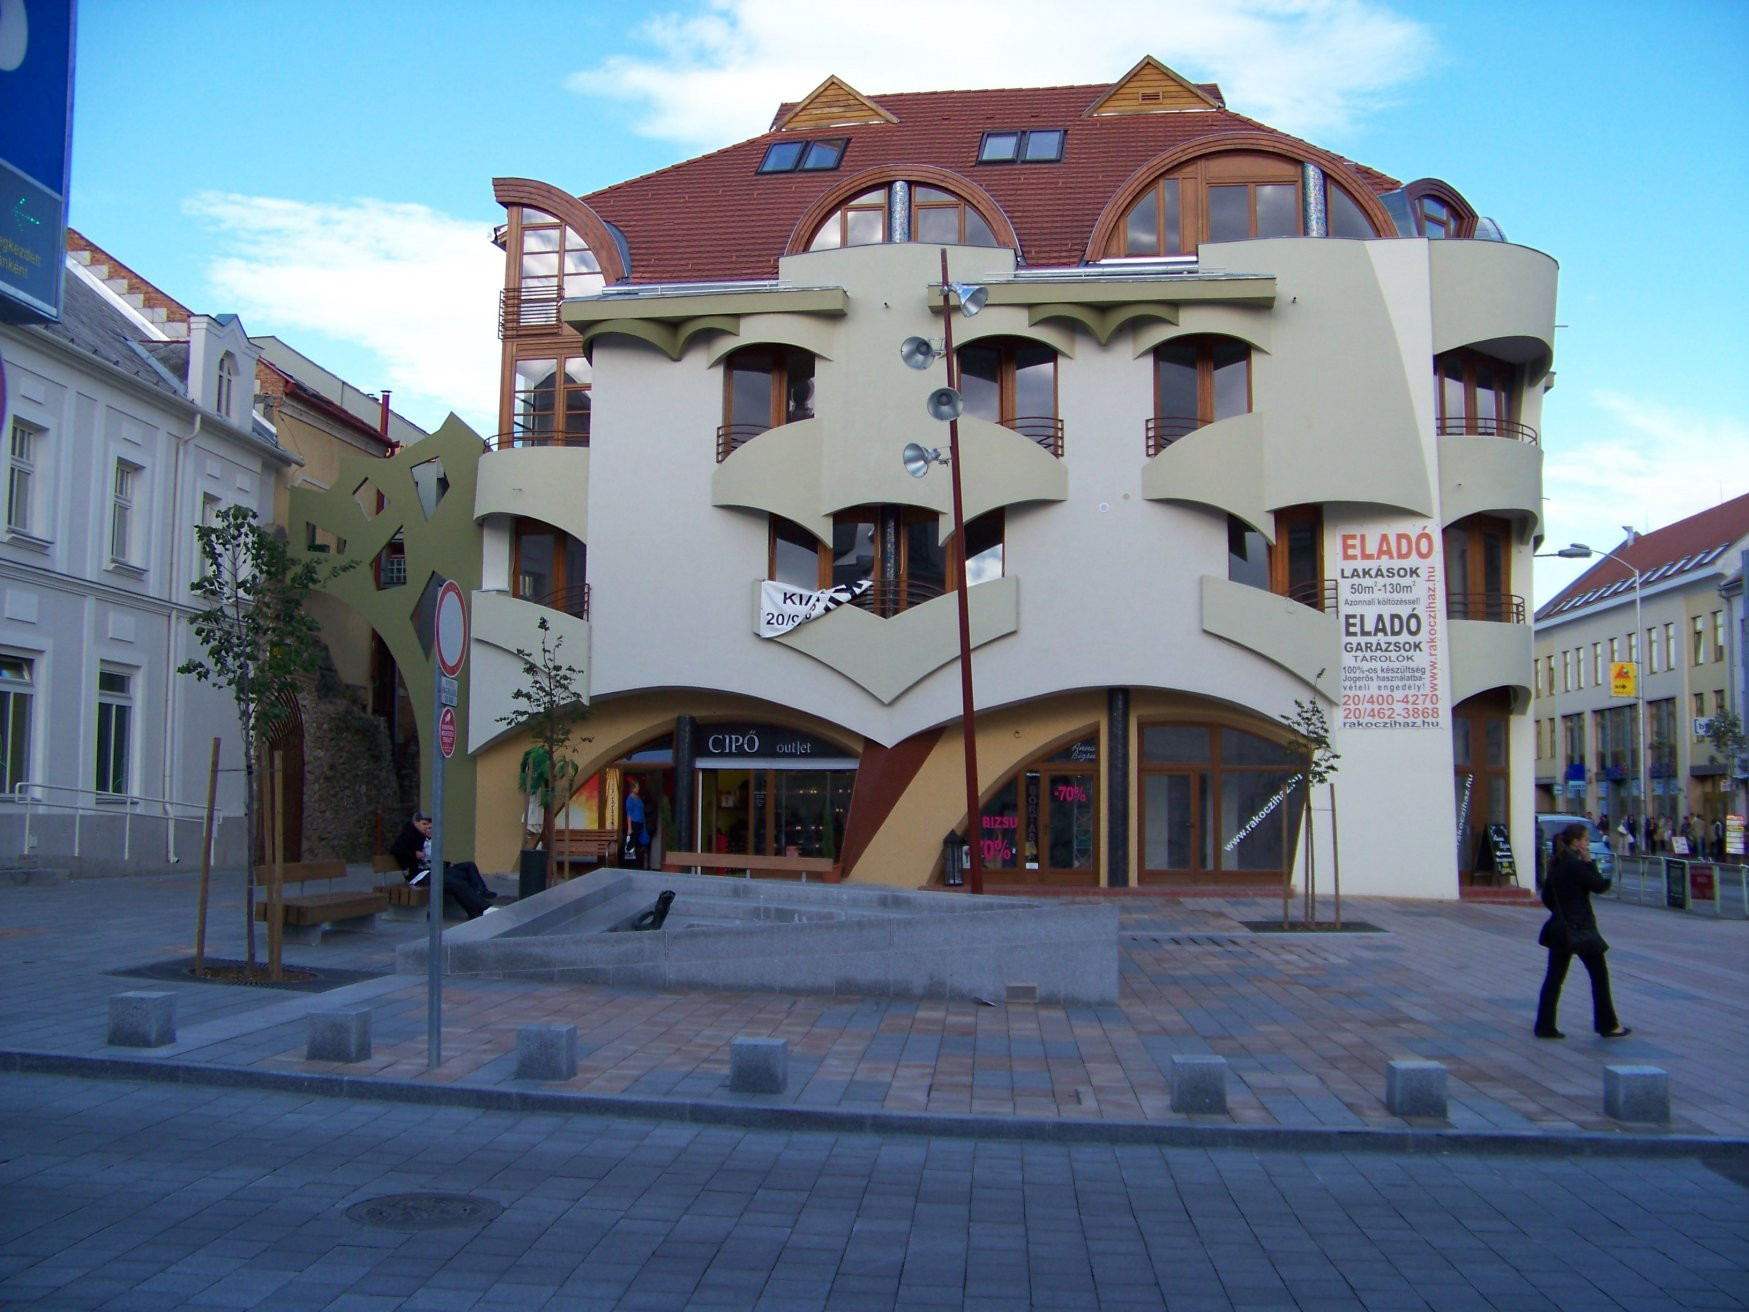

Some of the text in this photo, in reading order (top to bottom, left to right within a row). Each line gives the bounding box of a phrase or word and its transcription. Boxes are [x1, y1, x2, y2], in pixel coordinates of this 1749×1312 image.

[1341, 525, 1434, 560] ELADÓ
[1340, 564, 1421, 579] LAKÁSOK
[1344, 598, 1376, 606] Azonnali
[1344, 607, 1422, 637] ELADÓ
[1425, 566, 1438, 693] www.rakoczihaz.hu
[1344, 640, 1423, 653] GARÁZSOK
[1352, 653, 1415, 663] TÁROLÓK
[1342, 666, 1426, 675] 100%-os készültség
[1342, 674, 1426, 683] Jogerős használatba-
[1342, 683, 1426, 693] vételi engedély!
[1343, 694, 1439, 706] 20/400-4270
[1343, 707, 1440, 720] 20/462-3868
[1343, 719, 1440, 729] rakoczihaz.hu
[708, 730, 811, 755] CIPŐ outlet
[1054, 785, 1087, 802] -70%
[982, 816, 1018, 829] BIZSU
[981, 840, 1011, 861] 0%
